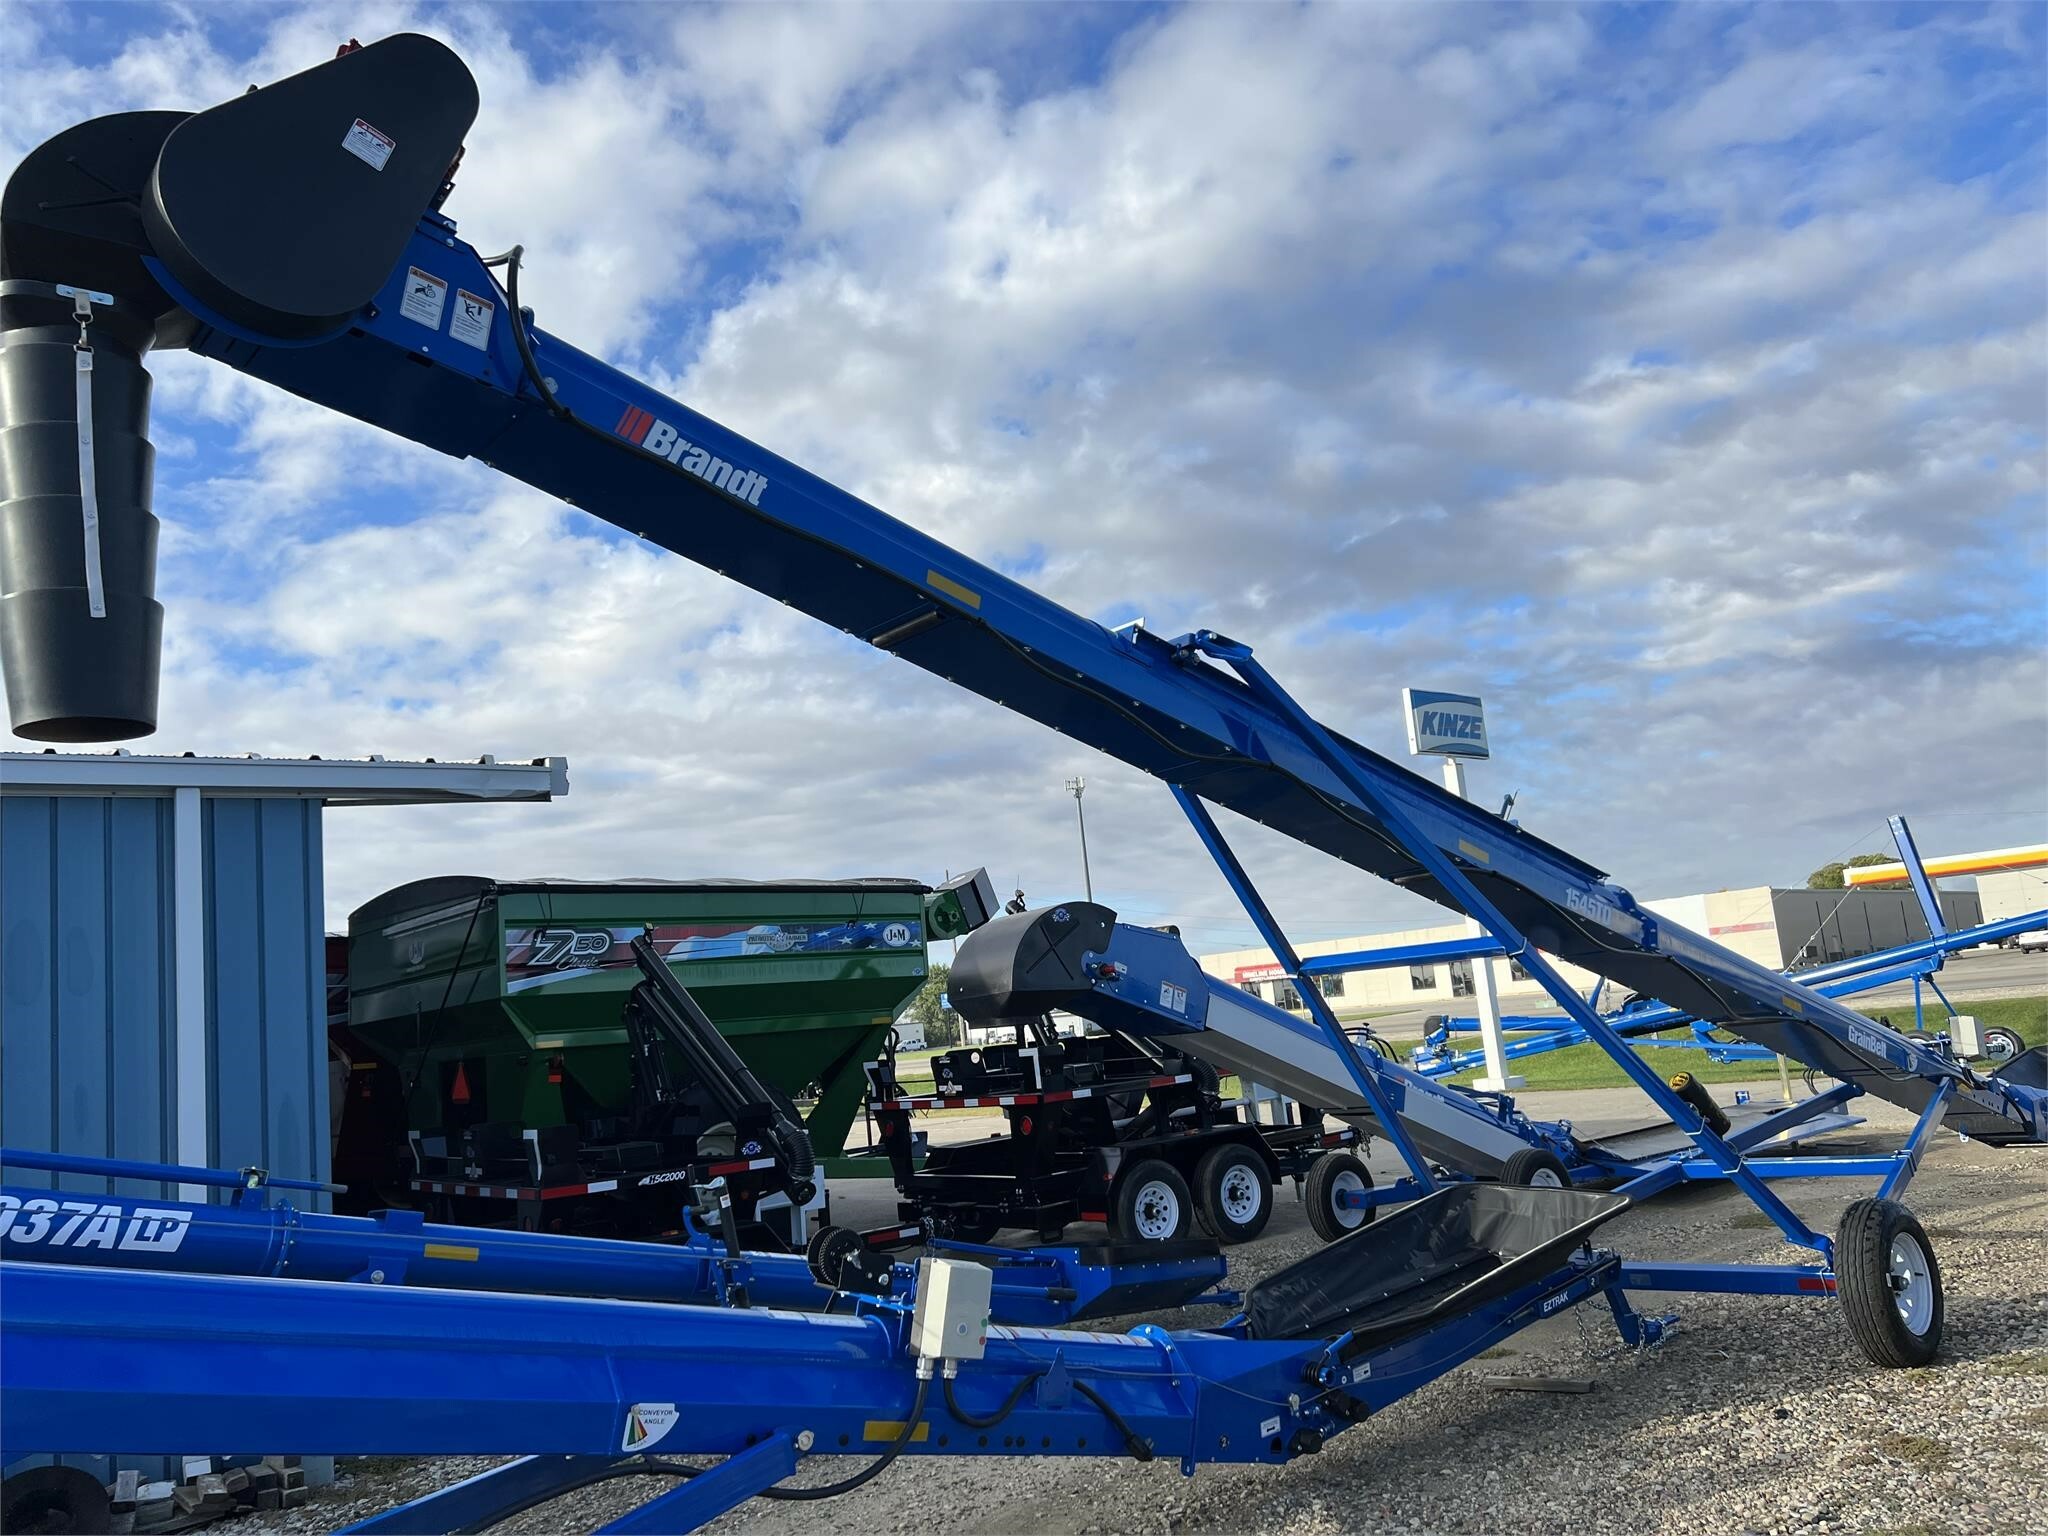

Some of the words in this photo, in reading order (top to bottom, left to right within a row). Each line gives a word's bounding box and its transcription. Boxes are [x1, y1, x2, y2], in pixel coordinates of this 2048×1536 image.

[642, 419, 768, 506] Brandt
[1421, 710, 1482, 740] KINZE
[527, 929, 609, 966] 750
[886, 928, 906, 942] J&M
[1848, 1024, 1887, 1060] GrainBelt
[1543, 1290, 1569, 1313] EZTRAK
